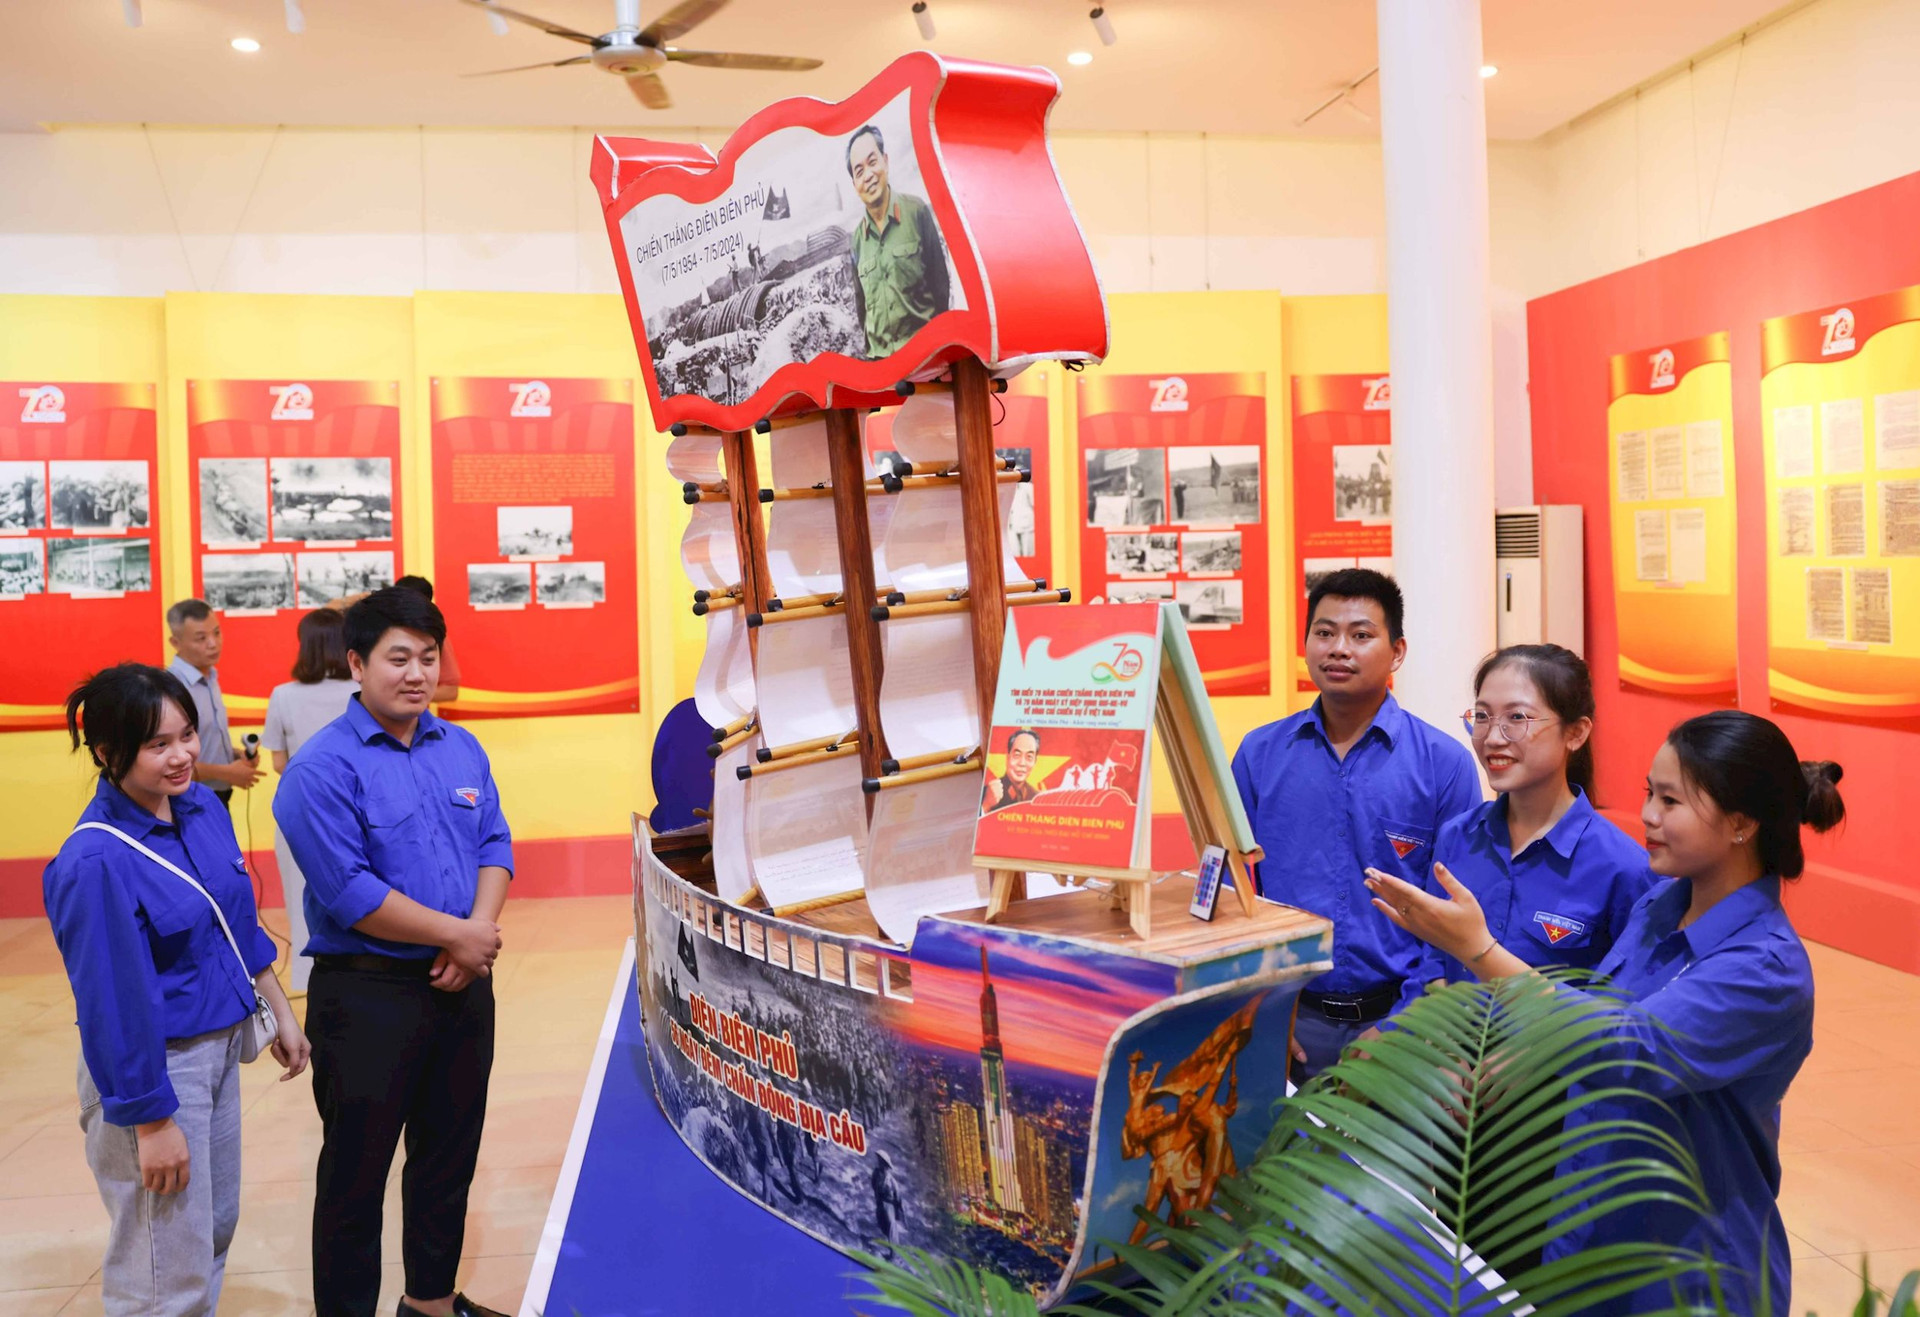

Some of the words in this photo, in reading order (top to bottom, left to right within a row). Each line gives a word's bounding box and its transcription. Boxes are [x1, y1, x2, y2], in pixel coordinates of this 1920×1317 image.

[636, 233, 662, 264] CHIẾN
[664, 221, 695, 250] THẮNG
[696, 209, 719, 235] ĐIỆN
[719, 198, 743, 225] BIÊN
[744, 181, 766, 213] PHỦ
[661, 253, 698, 286] (7/5/1954
[704, 230, 744, 263] 7/5/2024)
[690, 991, 719, 1042] ĐIỆN
[719, 1011, 757, 1062] BIÊN
[758, 1030, 798, 1081] PHỦ
[700, 1045, 723, 1085] ĐÊM
[723, 1061, 757, 1106] CHẤN
[757, 1080, 797, 1126] ĐỘNG
[798, 1100, 827, 1141] ĐỊA
[828, 1109, 866, 1155] CẦU
